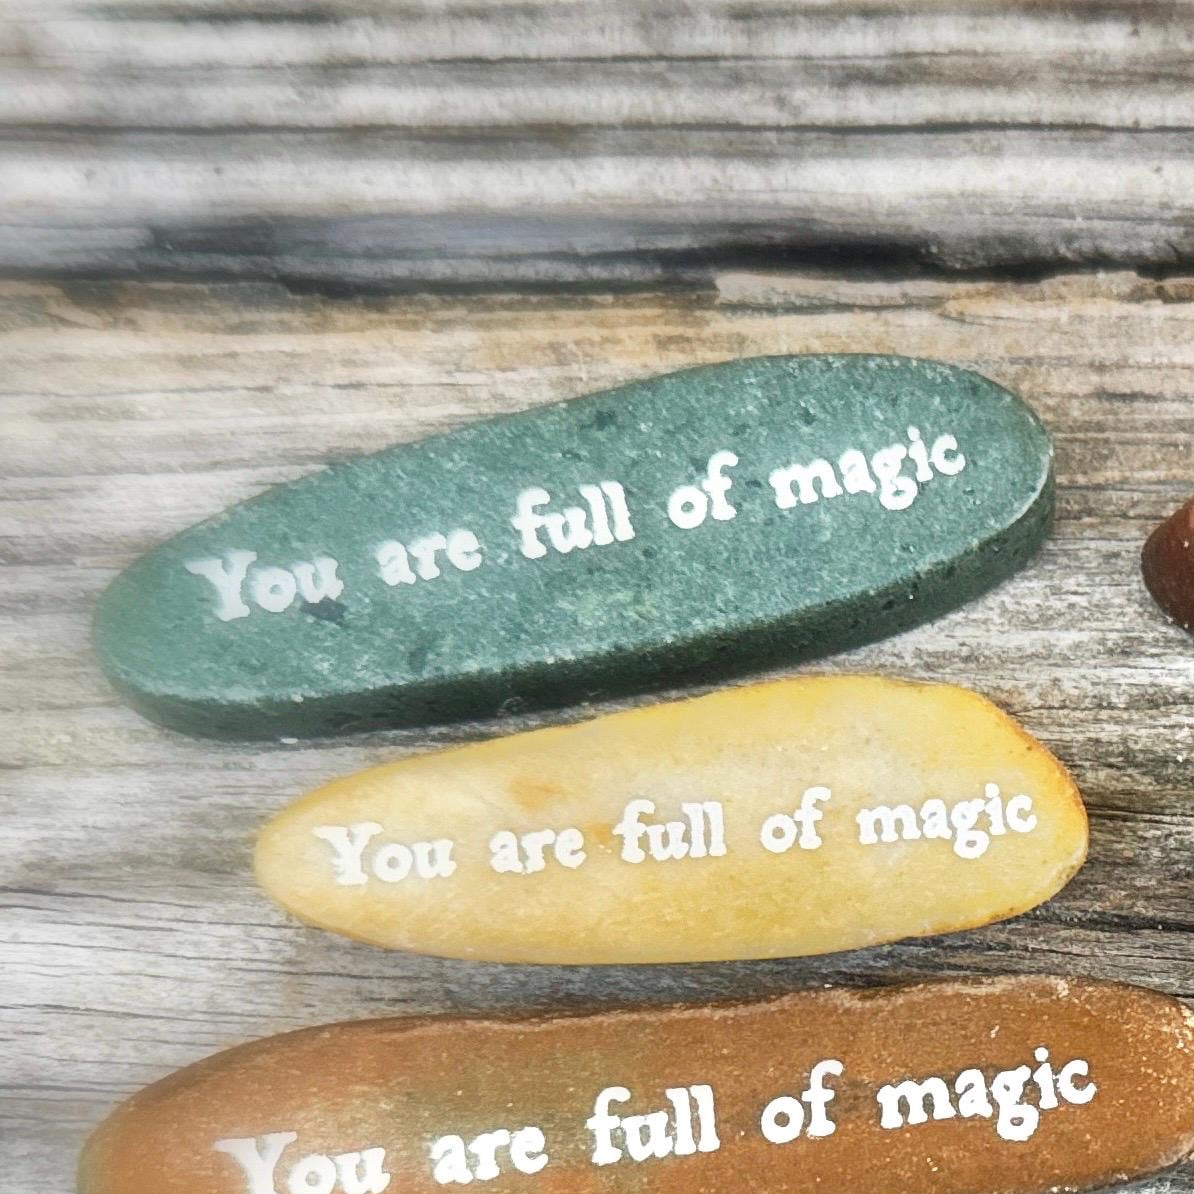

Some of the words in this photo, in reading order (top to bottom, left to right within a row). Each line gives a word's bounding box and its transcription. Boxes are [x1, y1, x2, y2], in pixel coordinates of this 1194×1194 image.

[187, 550, 343, 621] You
[376, 528, 483, 586] are
[512, 479, 634, 558] full
[667, 451, 737, 527] of
[769, 427, 965, 510] magic
[317, 824, 455, 884] You
[489, 822, 587, 874] are
[612, 798, 725, 864] full
[759, 786, 835, 853] of
[858, 783, 1037, 858] magic
[430, 1123, 547, 1184] are
[588, 1083, 719, 1167] full
[759, 1059, 844, 1143] of
[876, 1047, 1097, 1141] magic
